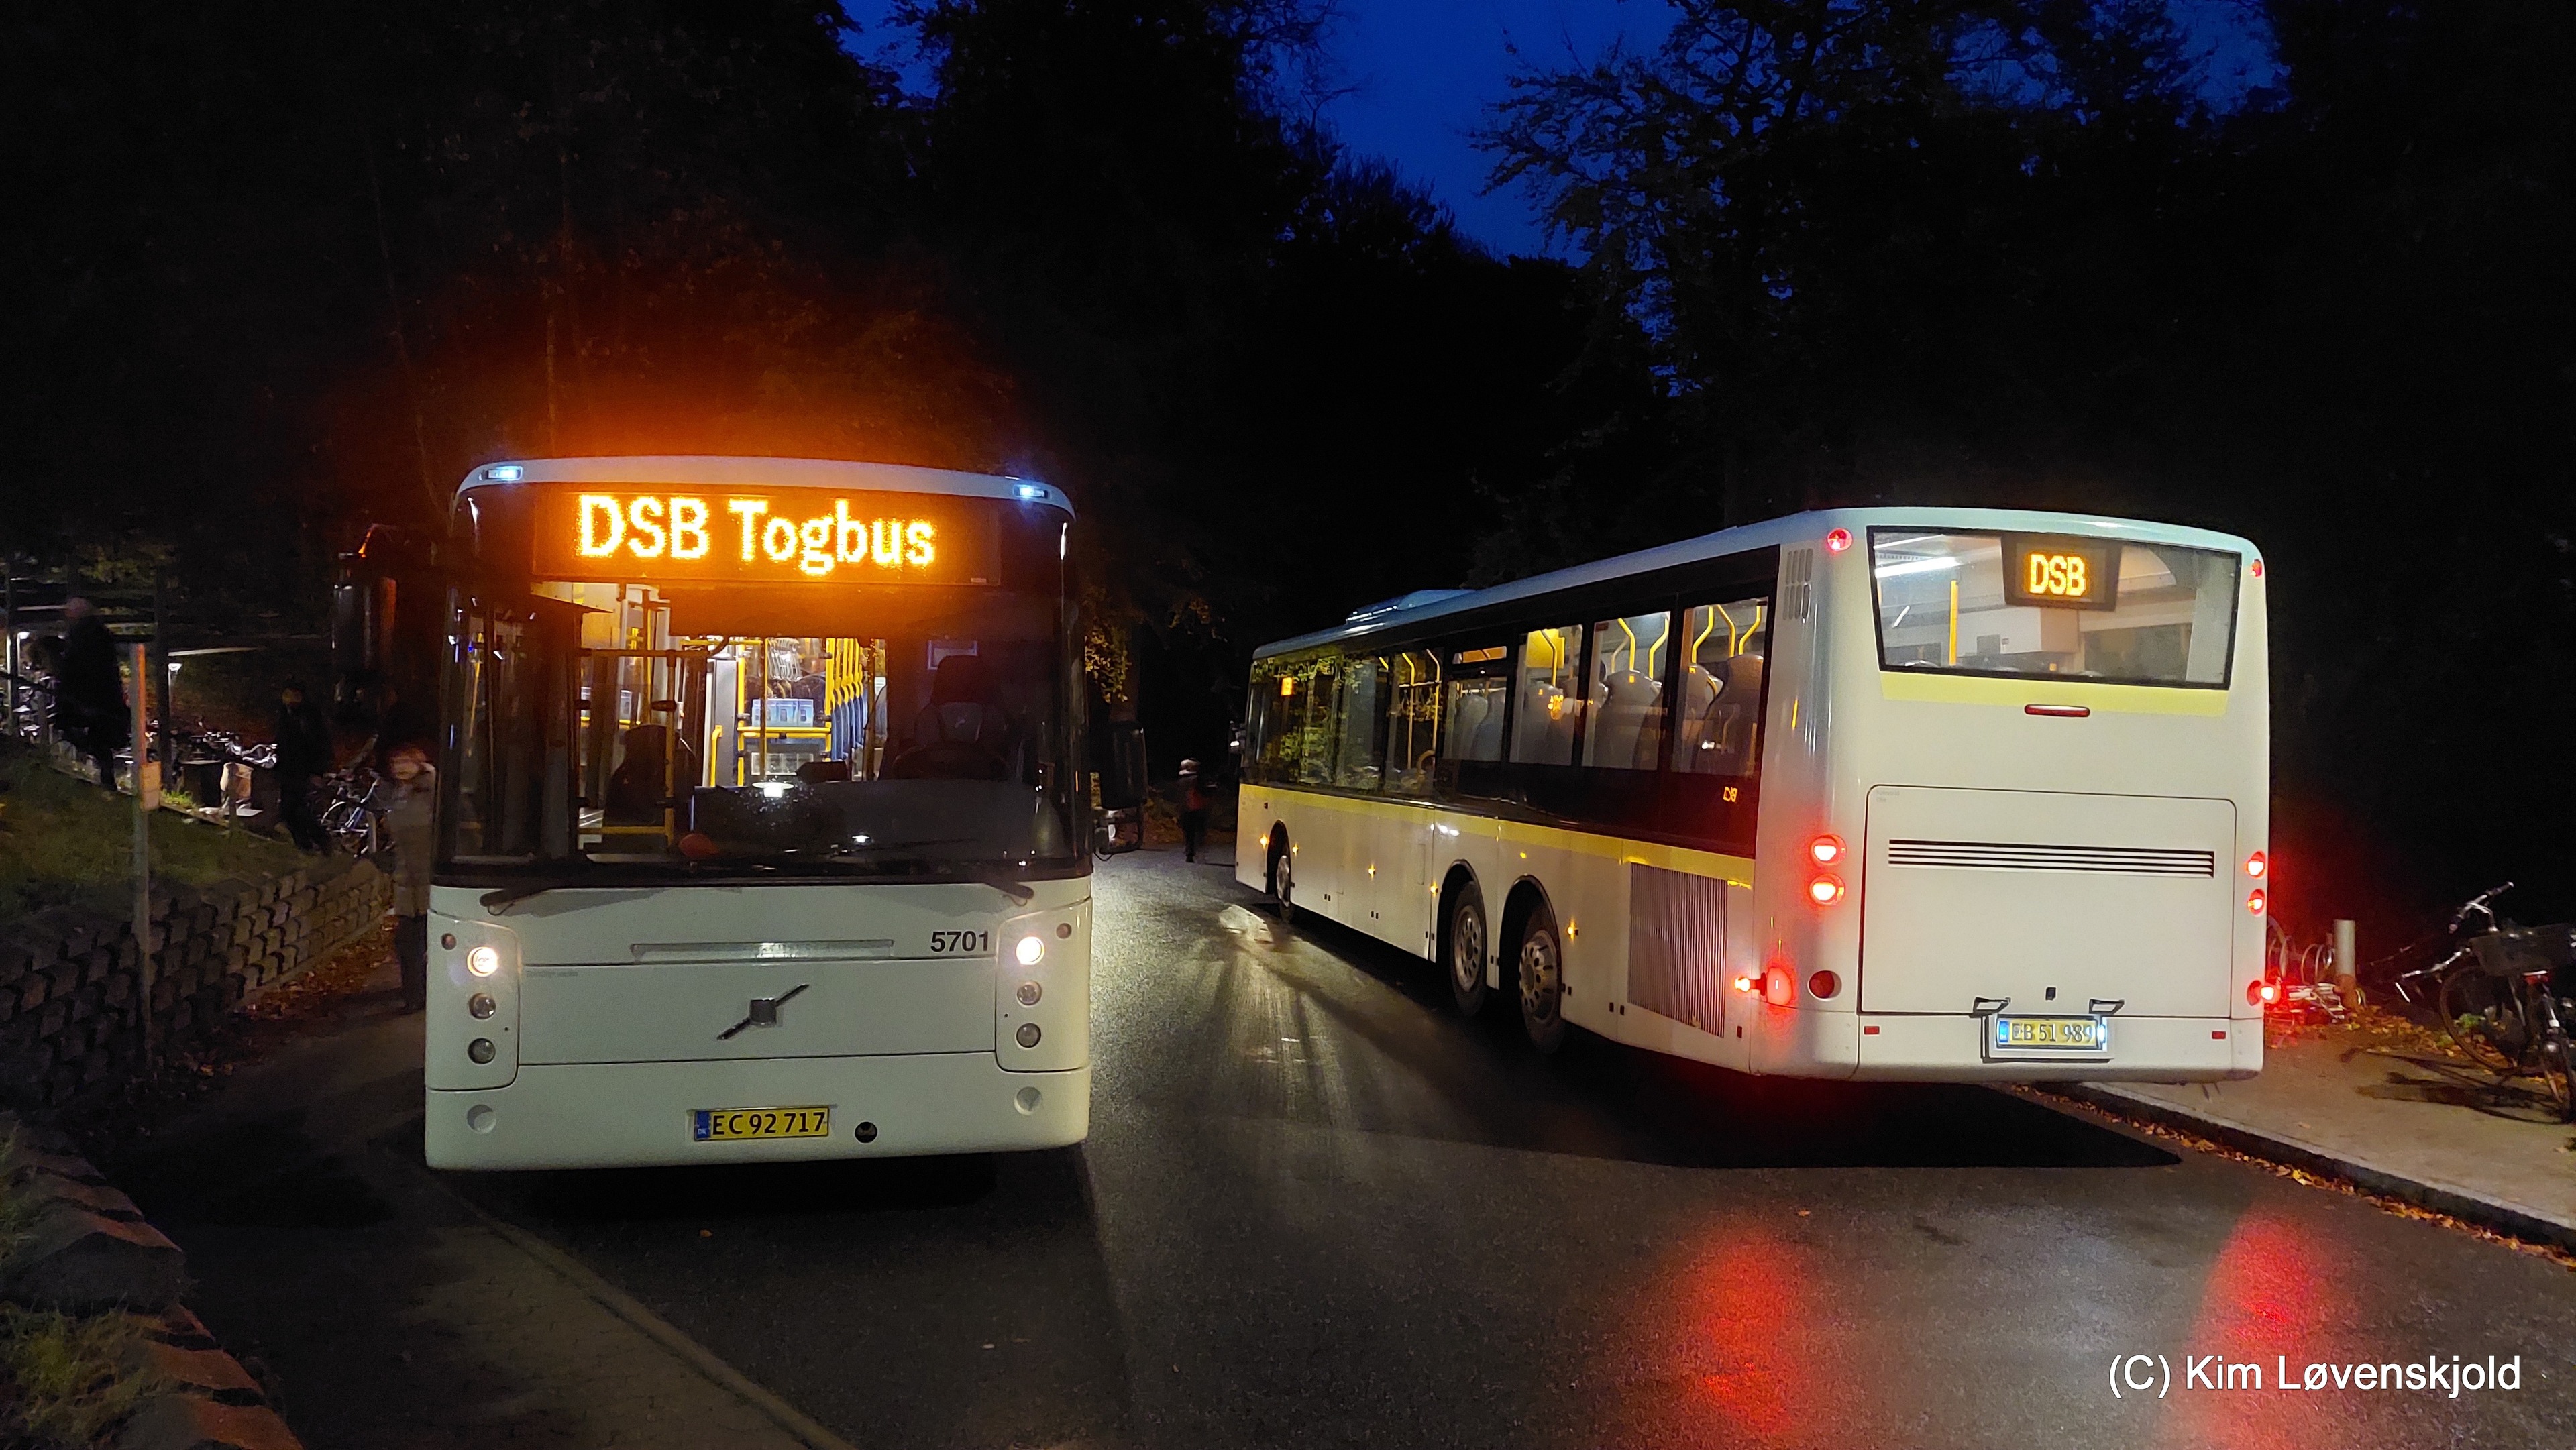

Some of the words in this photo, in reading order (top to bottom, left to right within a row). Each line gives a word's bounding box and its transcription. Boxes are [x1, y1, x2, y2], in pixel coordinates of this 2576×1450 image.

[578, 494, 711, 559] DSB
[728, 498, 939, 577] Togbus
[2030, 554, 2086, 596] DSB
[930, 931, 988, 952] 5701
[2012, 1023, 2033, 1041] EB
[2039, 1024, 2056, 1042] 51
[2063, 1025, 2096, 1042] 989
[713, 1114, 743, 1135] EC
[749, 1113, 777, 1134] 92
[784, 1112, 825, 1133] 717
